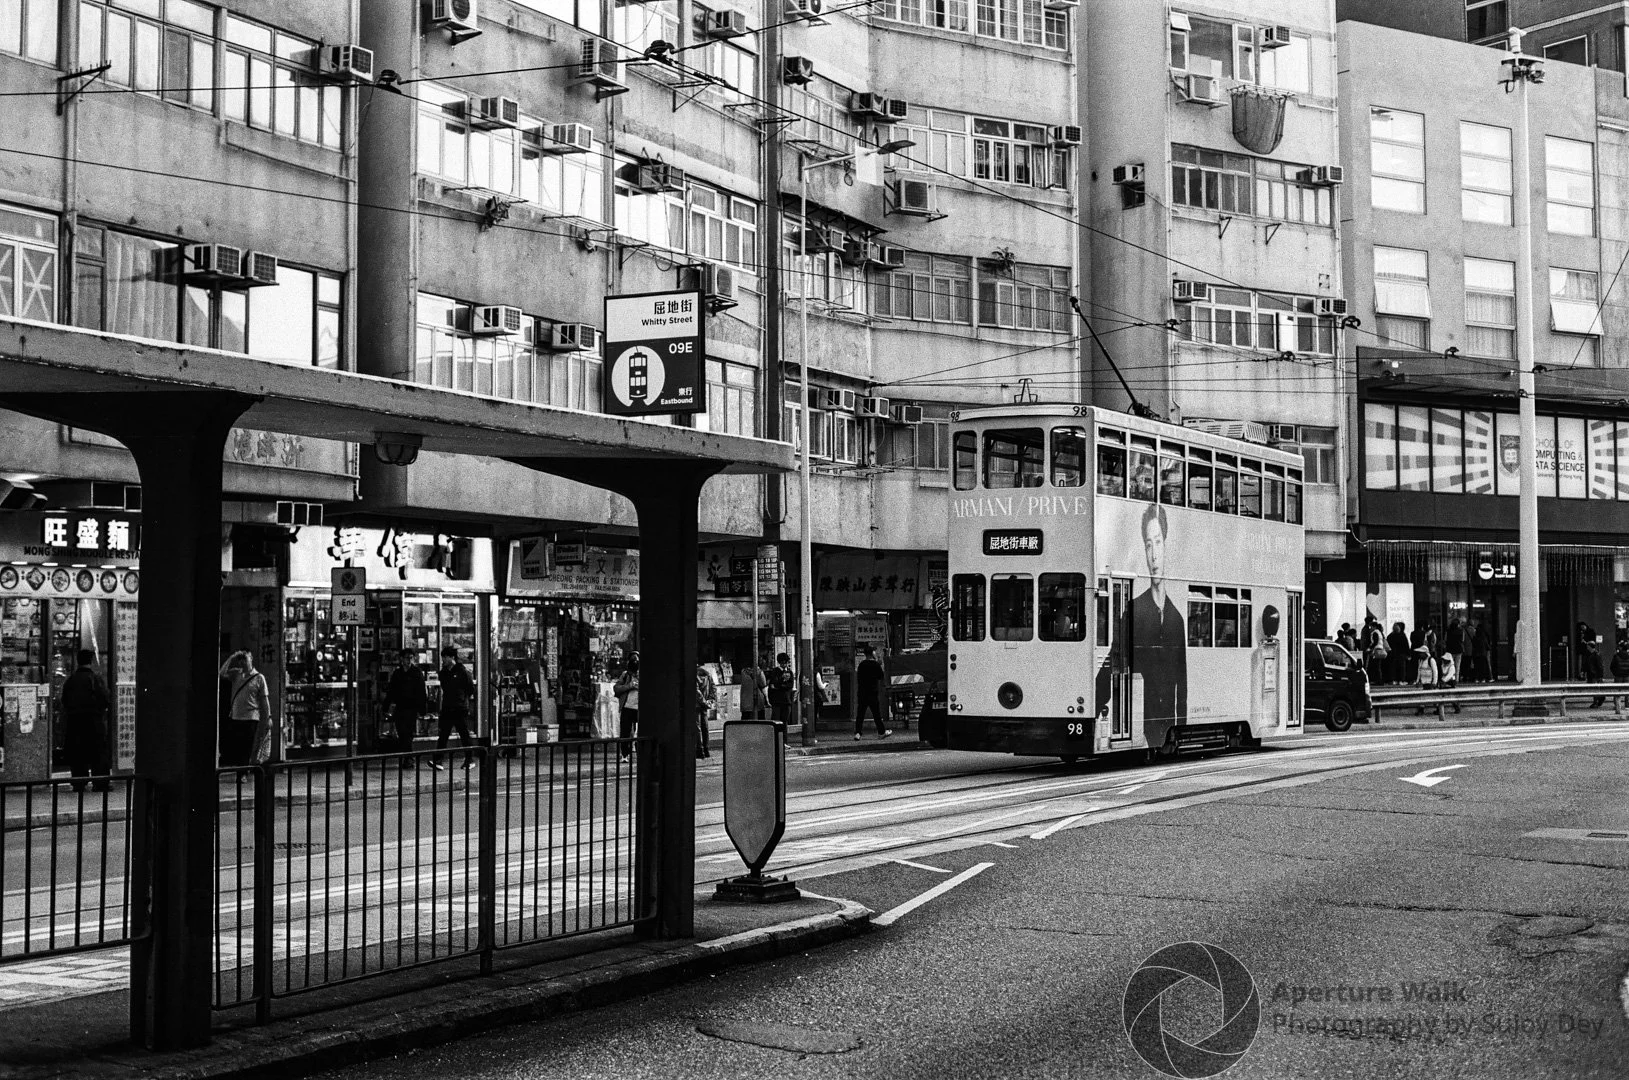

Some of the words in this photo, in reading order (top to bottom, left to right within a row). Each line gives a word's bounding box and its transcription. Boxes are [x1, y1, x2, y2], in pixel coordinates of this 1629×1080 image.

[654, 299, 692, 315] 屈地街
[641, 318, 667, 326] Whitty
[669, 316, 693, 324] Street
[668, 342, 693, 354] 09E
[660, 397, 693, 405] Eastbound
[1073, 406, 1087, 417] 98
[1551, 462, 1584, 472] SCIENCE
[989, 536, 1039, 550] 屈地街車廠
[576, 576, 600, 586] PACKING
[341, 598, 356, 607] End
[1067, 723, 1080, 734] 98
